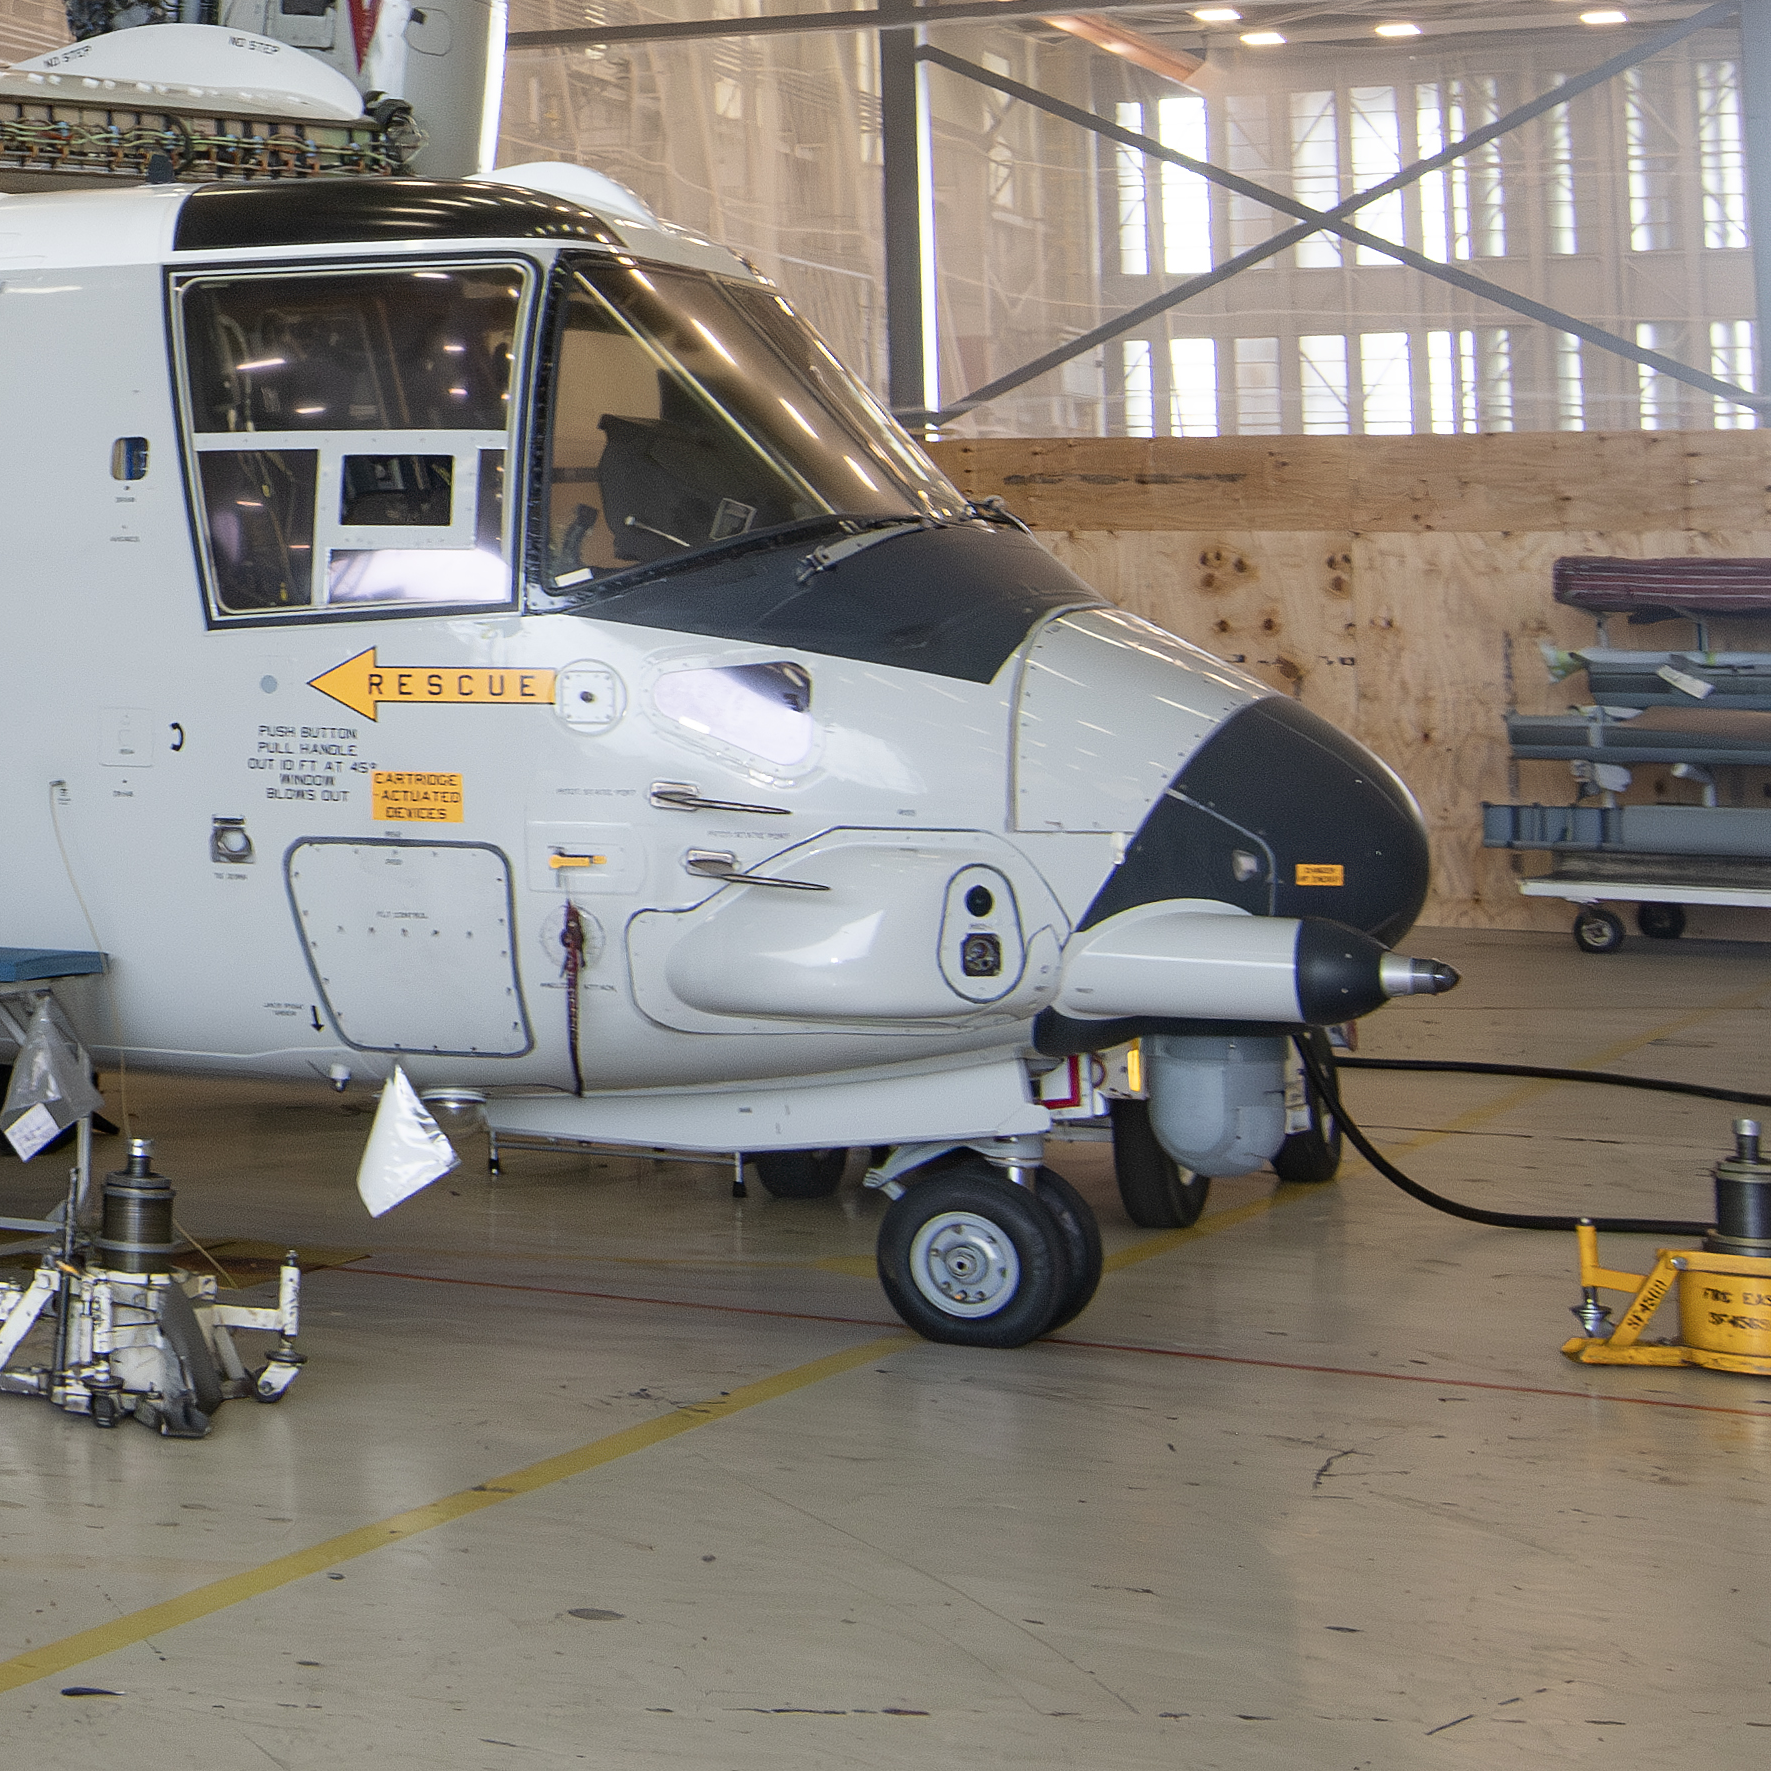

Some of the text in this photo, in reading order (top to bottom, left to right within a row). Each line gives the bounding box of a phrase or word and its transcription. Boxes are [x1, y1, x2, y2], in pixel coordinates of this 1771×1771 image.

[368, 674, 536, 697] RESCUE
[258, 725, 358, 739] PUSH BUTTON
[258, 741, 358, 756] PULL HANDLE
[247, 757, 275, 770] OUT
[280, 759, 294, 771] 10
[299, 760, 317, 771] FT
[324, 761, 344, 772] AT
[279, 773, 335, 786] WINDOW
[375, 773, 458, 786] CARTRIDGE
[266, 787, 350, 801] BLOWS OUT
[385, 807, 447, 820] DEVICES
